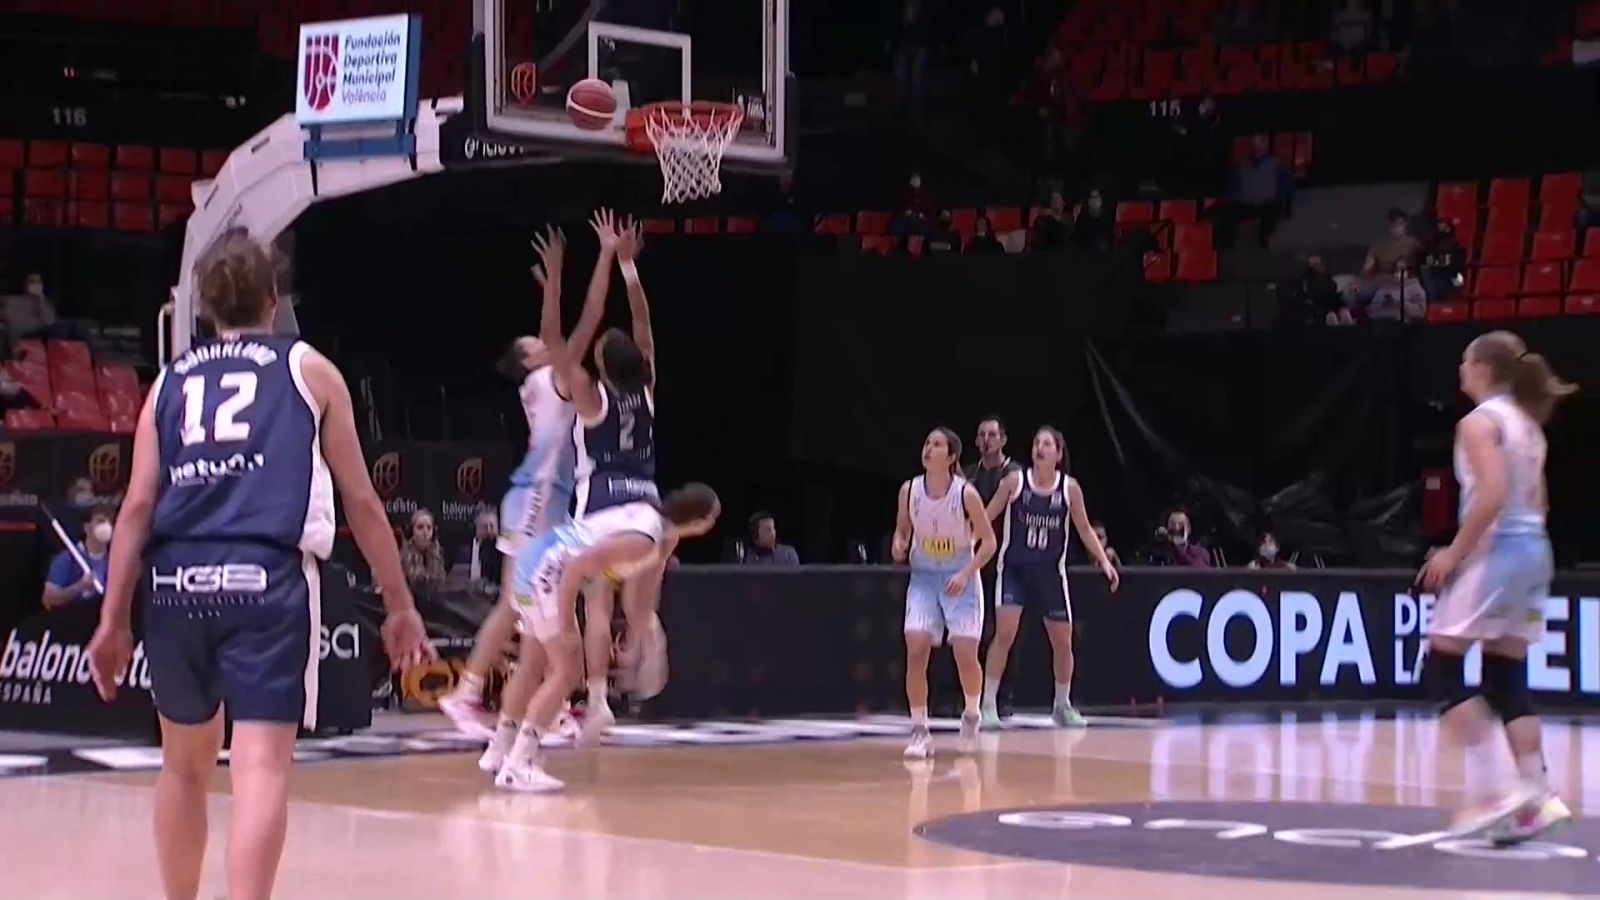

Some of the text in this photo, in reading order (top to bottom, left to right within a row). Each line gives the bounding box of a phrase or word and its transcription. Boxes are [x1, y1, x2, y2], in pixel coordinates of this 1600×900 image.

[345, 30, 401, 50] Fundación
[344, 50, 398, 71] Deportiva
[343, 67, 396, 87] Municipal
[180, 371, 258, 446] 12
[619, 411, 636, 451] 2
[152, 564, 267, 593] HGB
[1148, 588, 1377, 689] COPA
[1394, 593, 1435, 636] DE
[0, 681, 52, 704] SPAÑA
